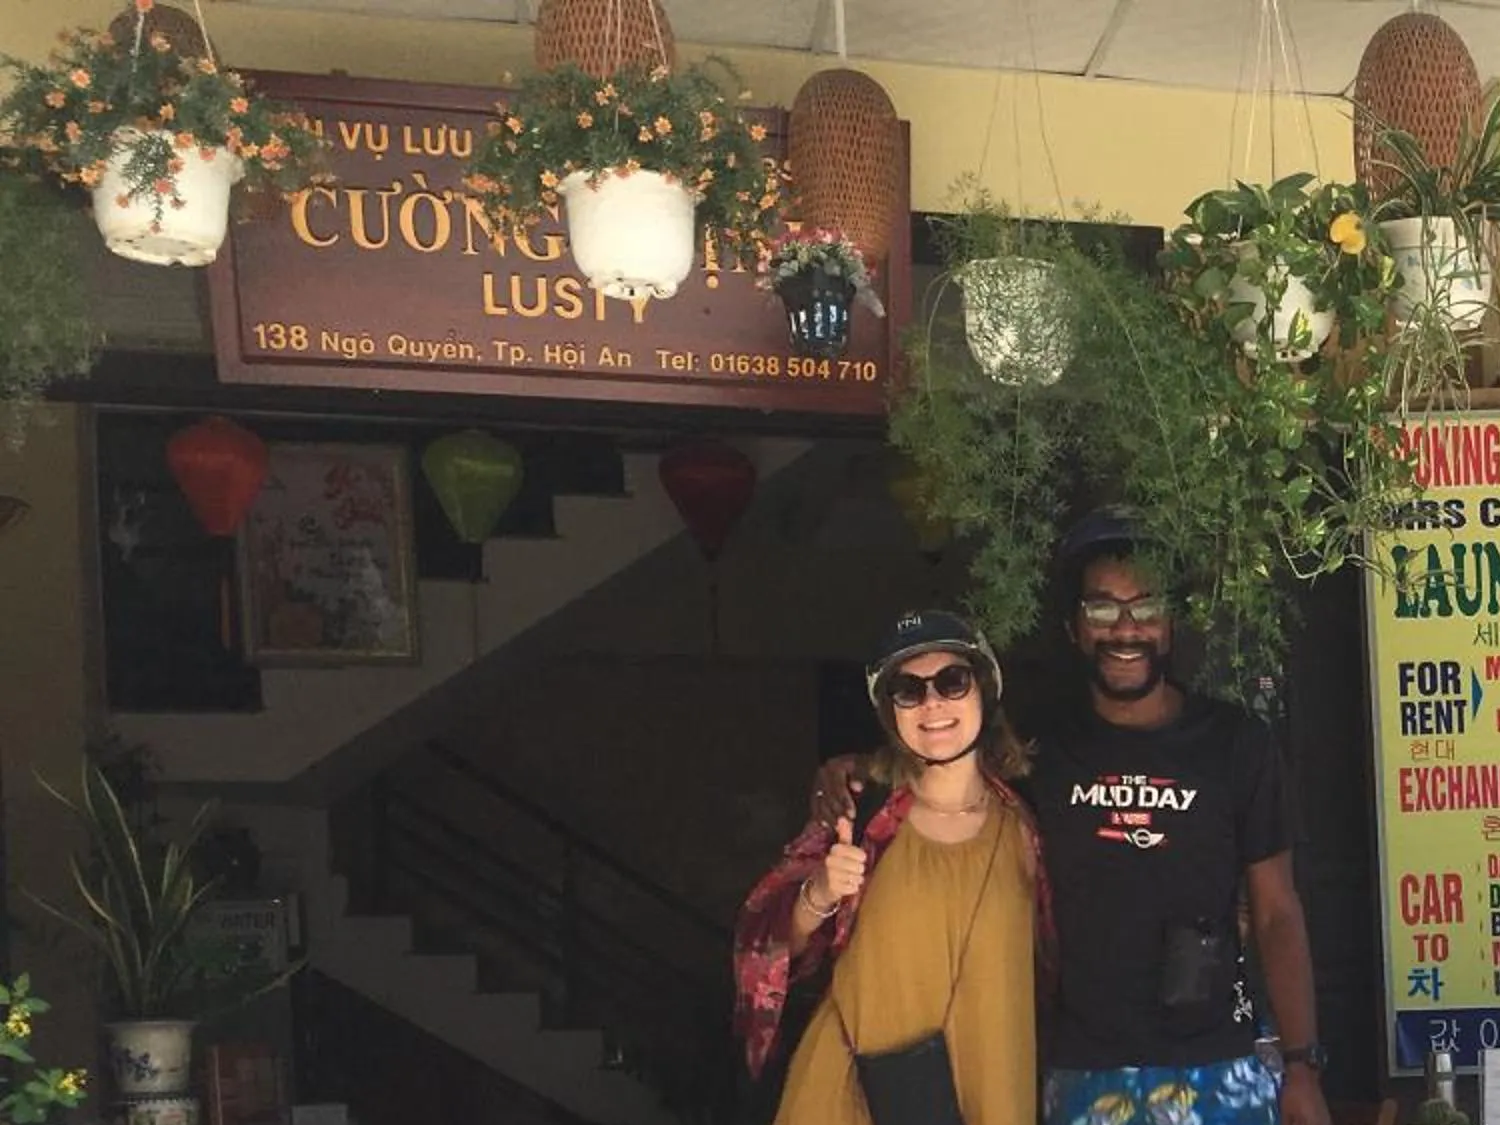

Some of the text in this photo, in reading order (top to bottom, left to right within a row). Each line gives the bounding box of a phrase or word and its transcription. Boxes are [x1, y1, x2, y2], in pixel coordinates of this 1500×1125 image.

[252, 322, 309, 351] 138
[491, 340, 533, 366] Tp.
[544, 343, 587, 370] Hội
[598, 346, 632, 368] An
[655, 350, 700, 372] Tel:
[710, 352, 781, 377] 01638
[786, 356, 831, 381] 504
[836, 360, 878, 383] 710
[1398, 660, 1462, 698] FOR
[1400, 698, 1467, 737] RENT
[1070, 783, 1198, 811] MUD DAY
[1400, 872, 1465, 927] CAR
[1412, 934, 1450, 963] TO
